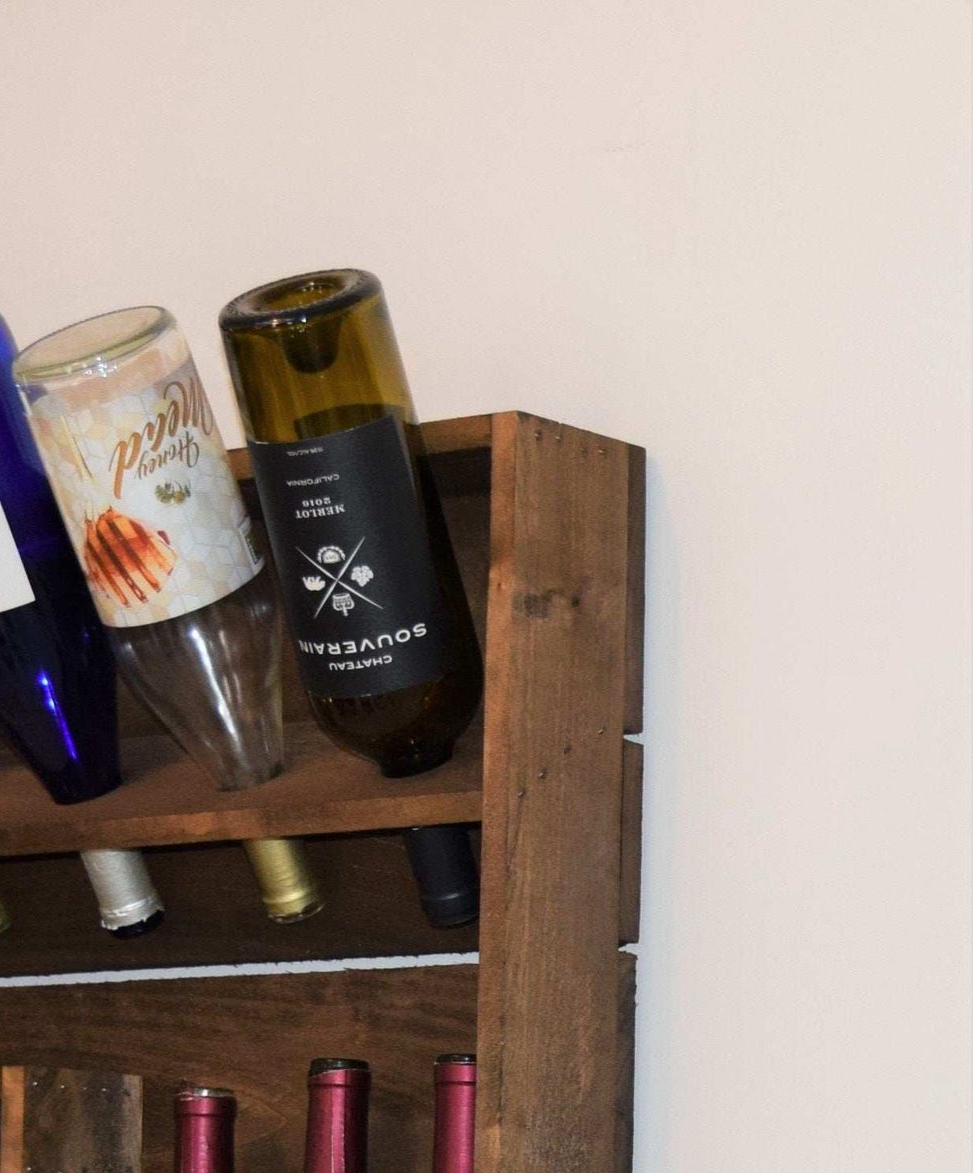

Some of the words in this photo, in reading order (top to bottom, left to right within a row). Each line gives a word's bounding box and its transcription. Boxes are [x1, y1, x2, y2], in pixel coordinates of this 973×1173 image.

[108, 376, 215, 500] Mead
[133, 431, 201, 481] Honey
[286, 473, 340, 488] CALIFORNIA
[295, 503, 346, 519] MERLOT
[298, 622, 428, 656] SOUVERAIN
[328, 654, 393, 671] CHATEAU
